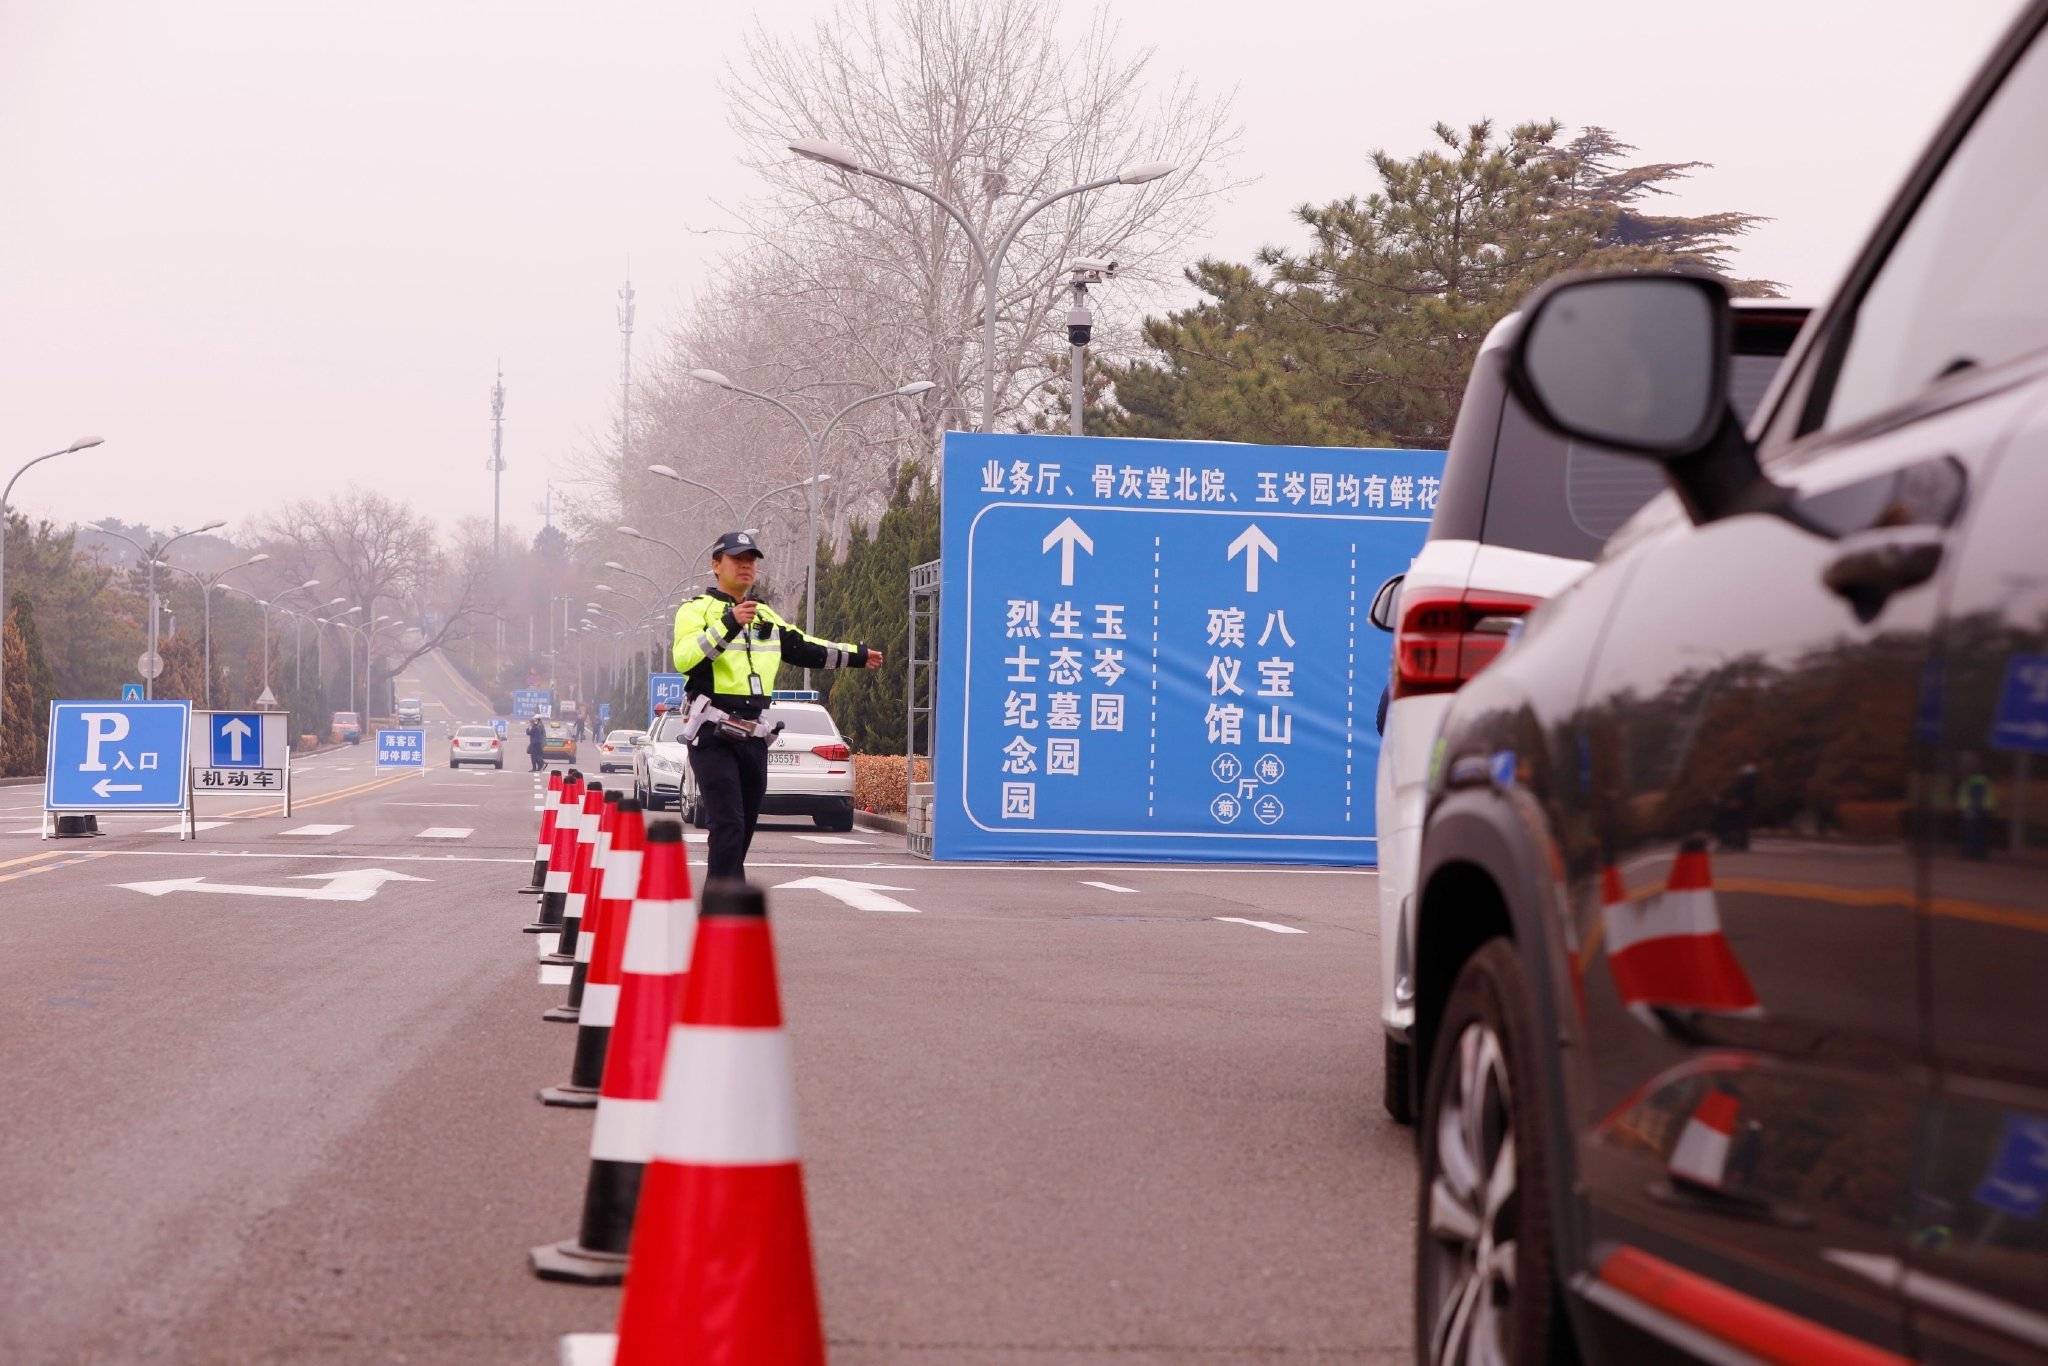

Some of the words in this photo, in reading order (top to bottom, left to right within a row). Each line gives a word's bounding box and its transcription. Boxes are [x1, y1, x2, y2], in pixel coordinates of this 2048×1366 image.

[1091, 604, 1127, 732] 玉岑园
[1205, 607, 1245, 745] 殡仪馆
[1257, 609, 1296, 745] 八宝山
[656, 683, 685, 698] 此门
[1046, 601, 1084, 776] 生态墓园
[1002, 600, 1041, 820] 烈士纪念园
[79, 712, 130, 772] P
[113, 751, 158, 771] 入口
[385, 735, 417, 747] 落客区
[380, 750, 421, 762] 即停即走
[1218, 759, 1235, 777] 竹
[1261, 760, 1278, 777] 梅
[202, 770, 275, 788] 机动车
[1236, 778, 1259, 800] 厅
[1217, 799, 1234, 818] 菊
